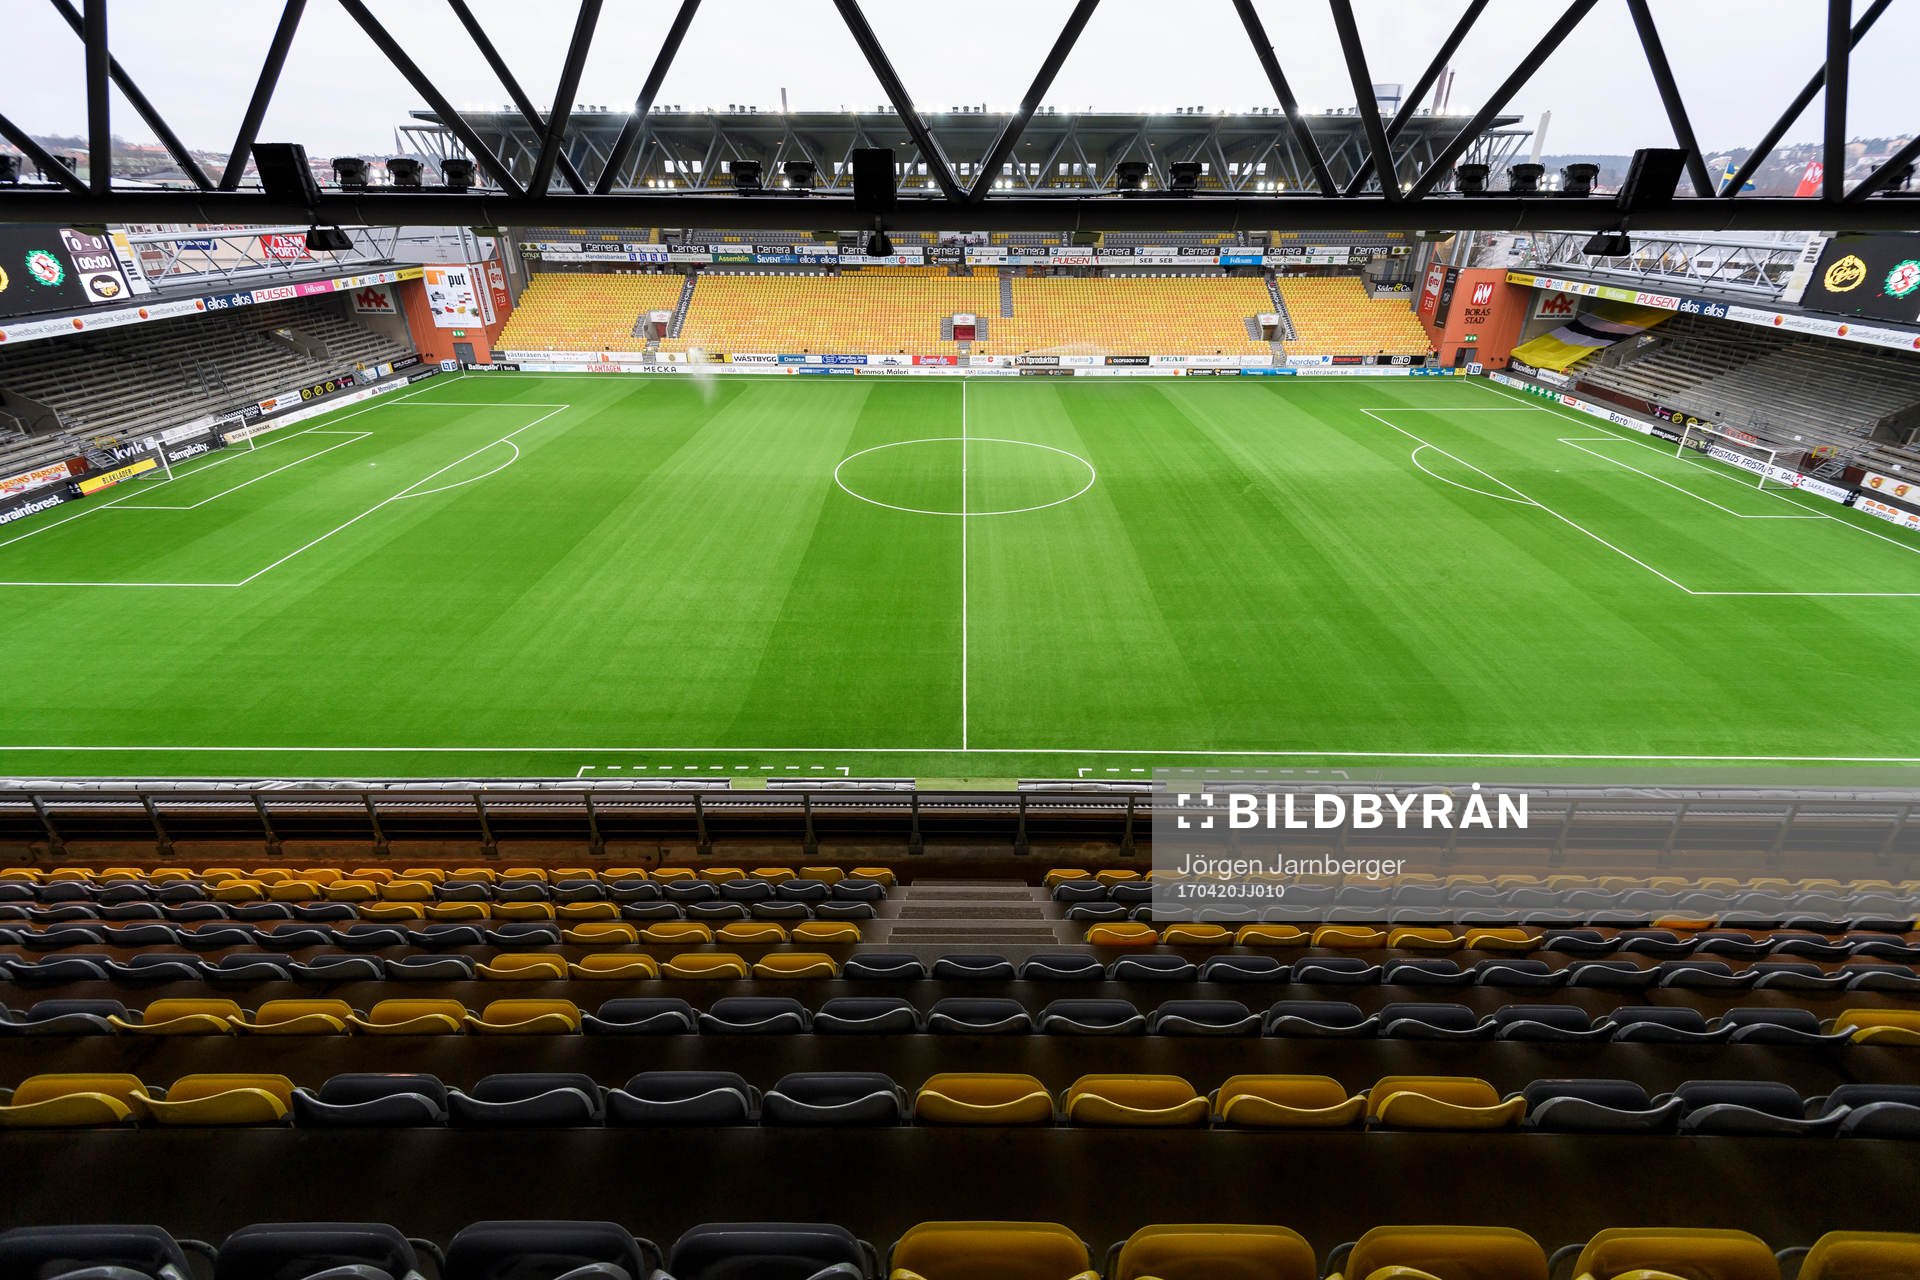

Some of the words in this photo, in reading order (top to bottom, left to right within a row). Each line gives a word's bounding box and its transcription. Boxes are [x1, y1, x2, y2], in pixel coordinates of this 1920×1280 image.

[71, 238, 82, 250] 0
[92, 237, 103, 250] 0
[276, 236, 304, 247] TEAM
[842, 247, 867, 255] Cerne
[79, 256, 112, 270] 00:00
[448, 273, 467, 288] put
[255, 286, 294, 301] PULSEN
[1637, 293, 1678, 309] PULSEN
[1464, 308, 1491, 317] BORÅS
[1464, 316, 1485, 325] STAD
[114, 442, 145, 460] kvik
[1740, 459, 1775, 476] FRISTAS
[0, 475, 31, 490] ARSONS
